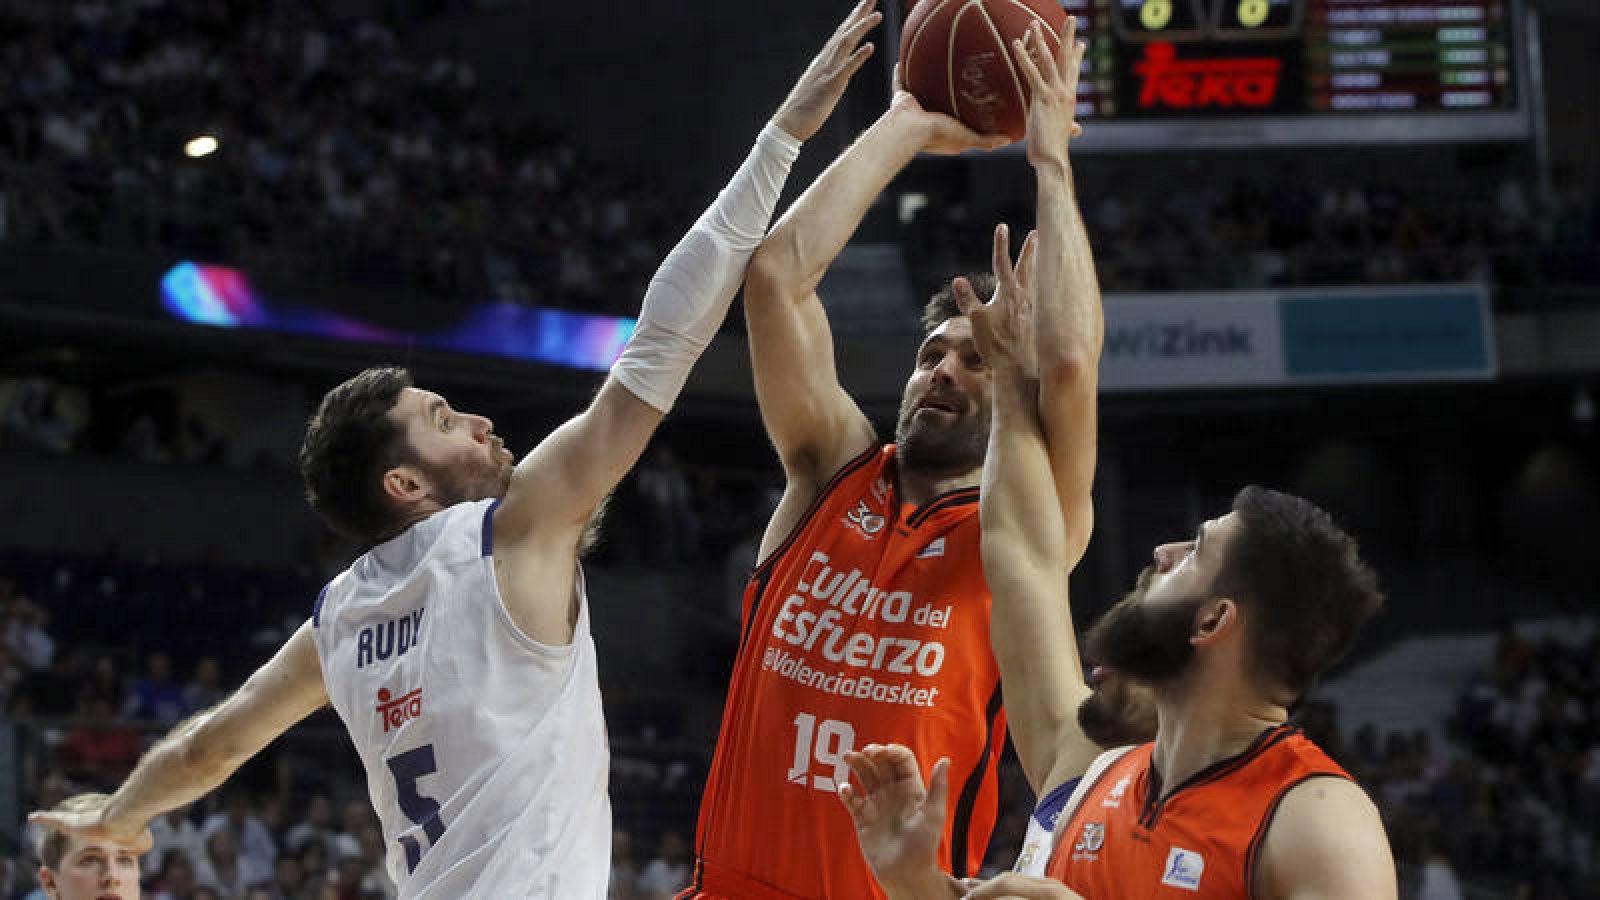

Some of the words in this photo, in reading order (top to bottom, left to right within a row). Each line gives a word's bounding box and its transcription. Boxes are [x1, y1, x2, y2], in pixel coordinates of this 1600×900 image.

[772, 594, 945, 677] Esfuerzo
[913, 603, 953, 628] del
[788, 712, 856, 793] 19
[386, 743, 447, 876] 5
